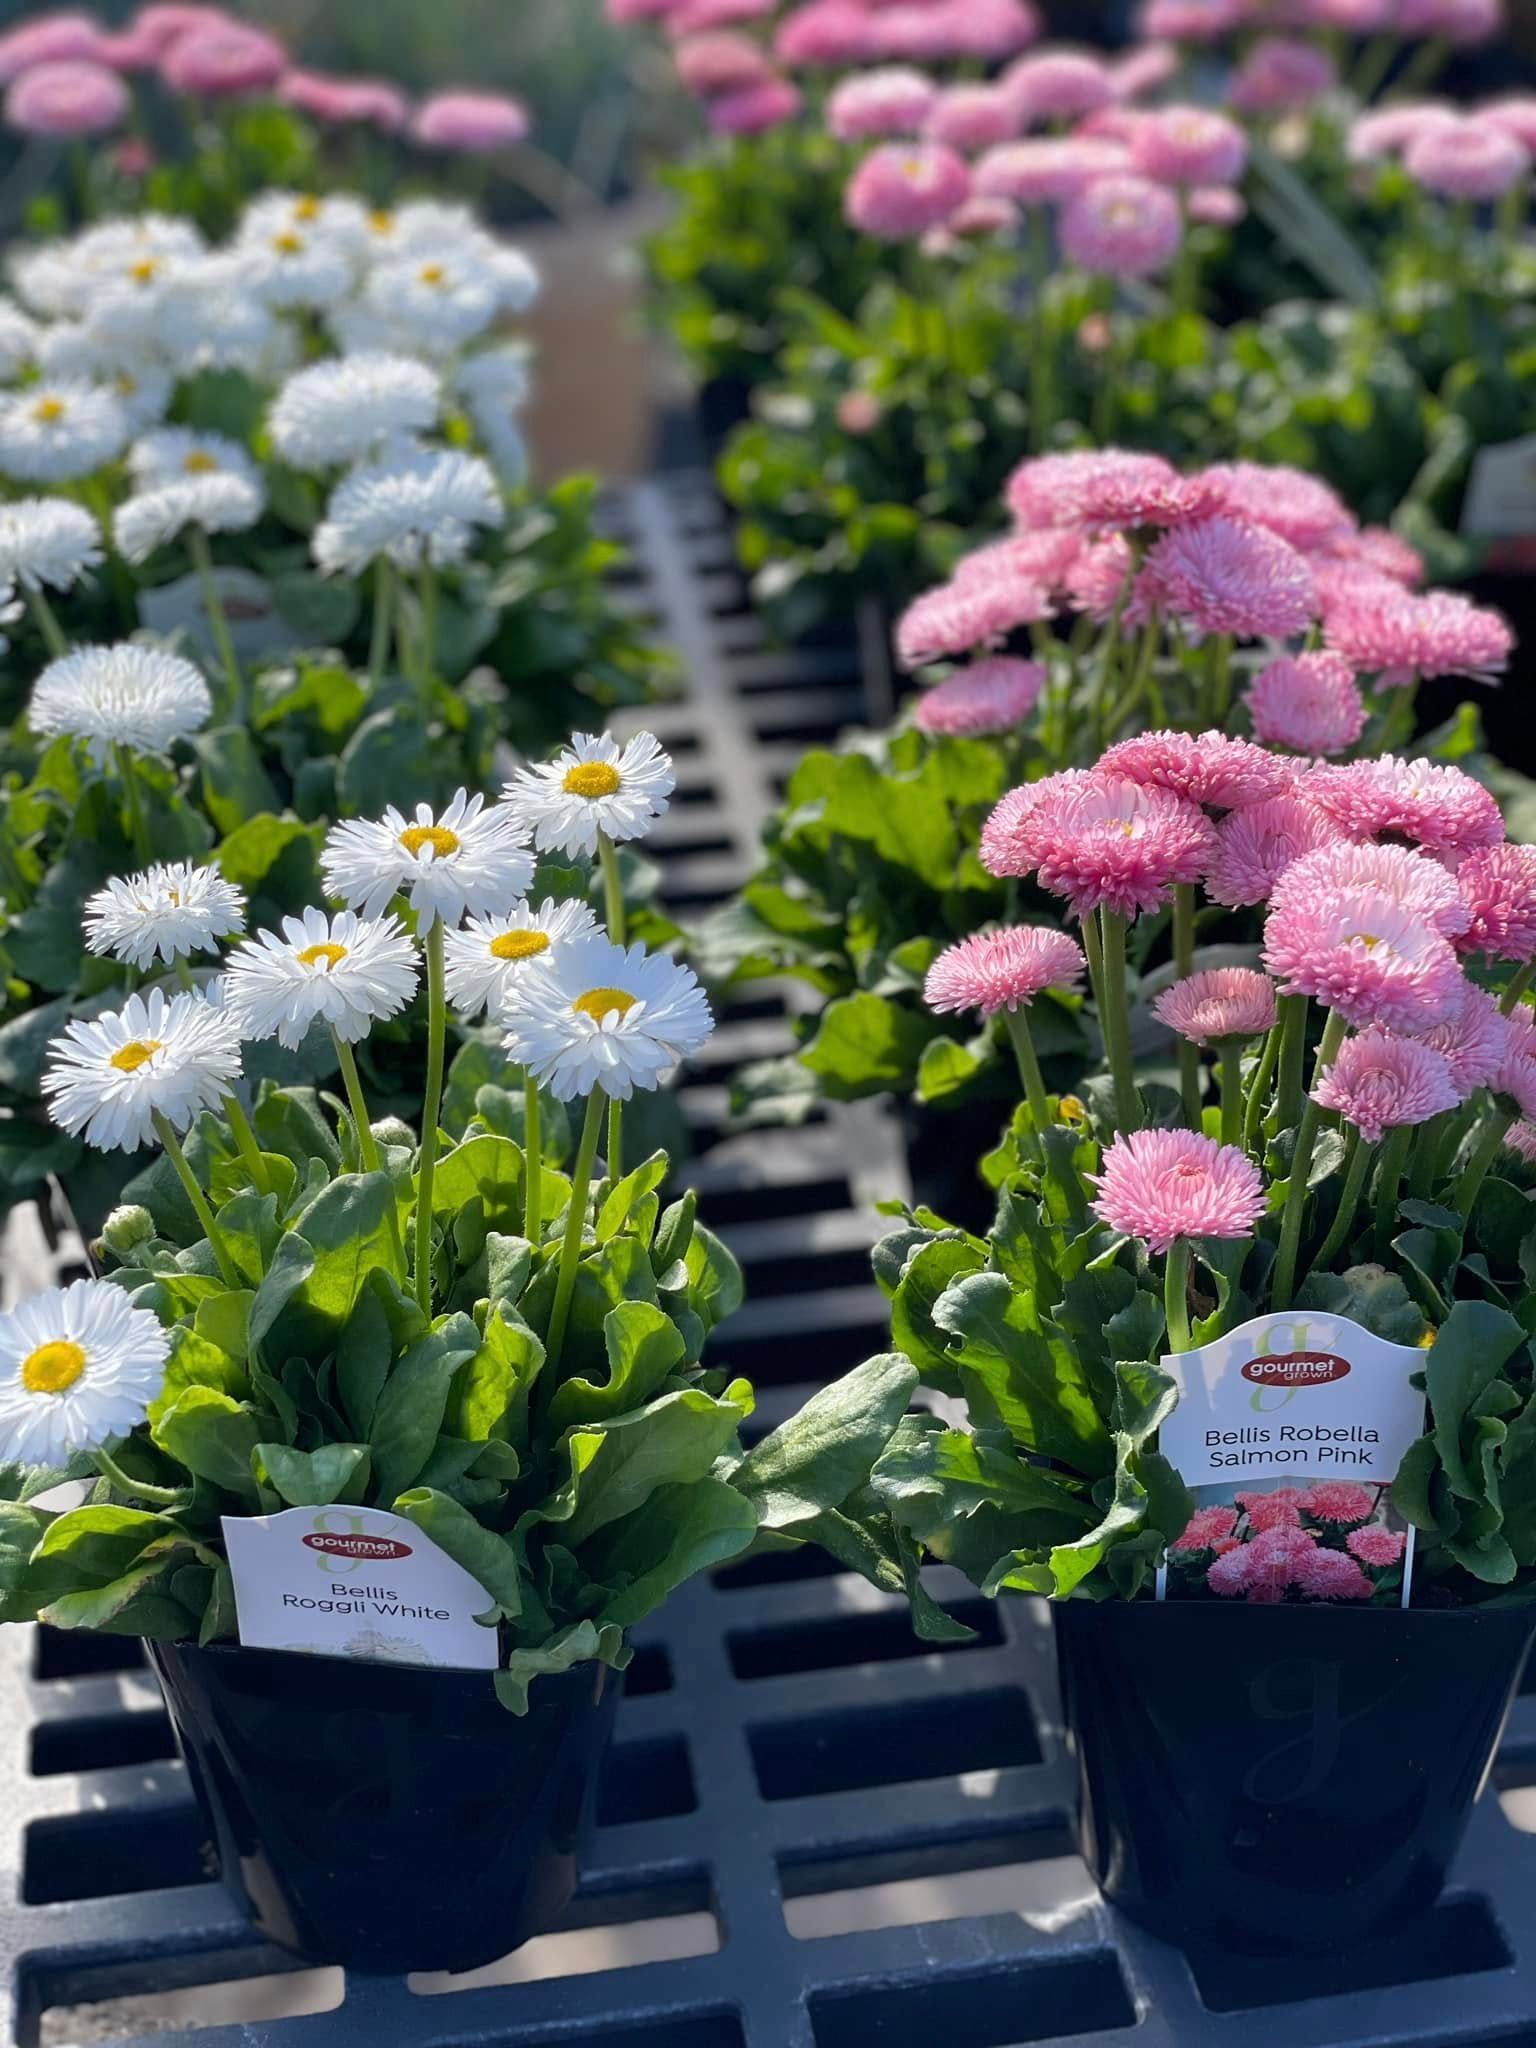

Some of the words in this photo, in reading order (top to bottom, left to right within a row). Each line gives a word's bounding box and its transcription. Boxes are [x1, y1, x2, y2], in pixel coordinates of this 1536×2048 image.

[1250, 1359, 1335, 1377] gourmet
[1284, 1371, 1333, 1380] grown
[1205, 1428, 1270, 1446] Bellis
[1280, 1425, 1379, 1443] Robella
[1209, 1449, 1308, 1467] Salmon
[1318, 1447, 1373, 1464] Pink
[311, 1536, 395, 1552] gourmet
[331, 1583, 398, 1600] Bellis
[282, 1593, 365, 1614] Roggli
[373, 1602, 450, 1620] White
